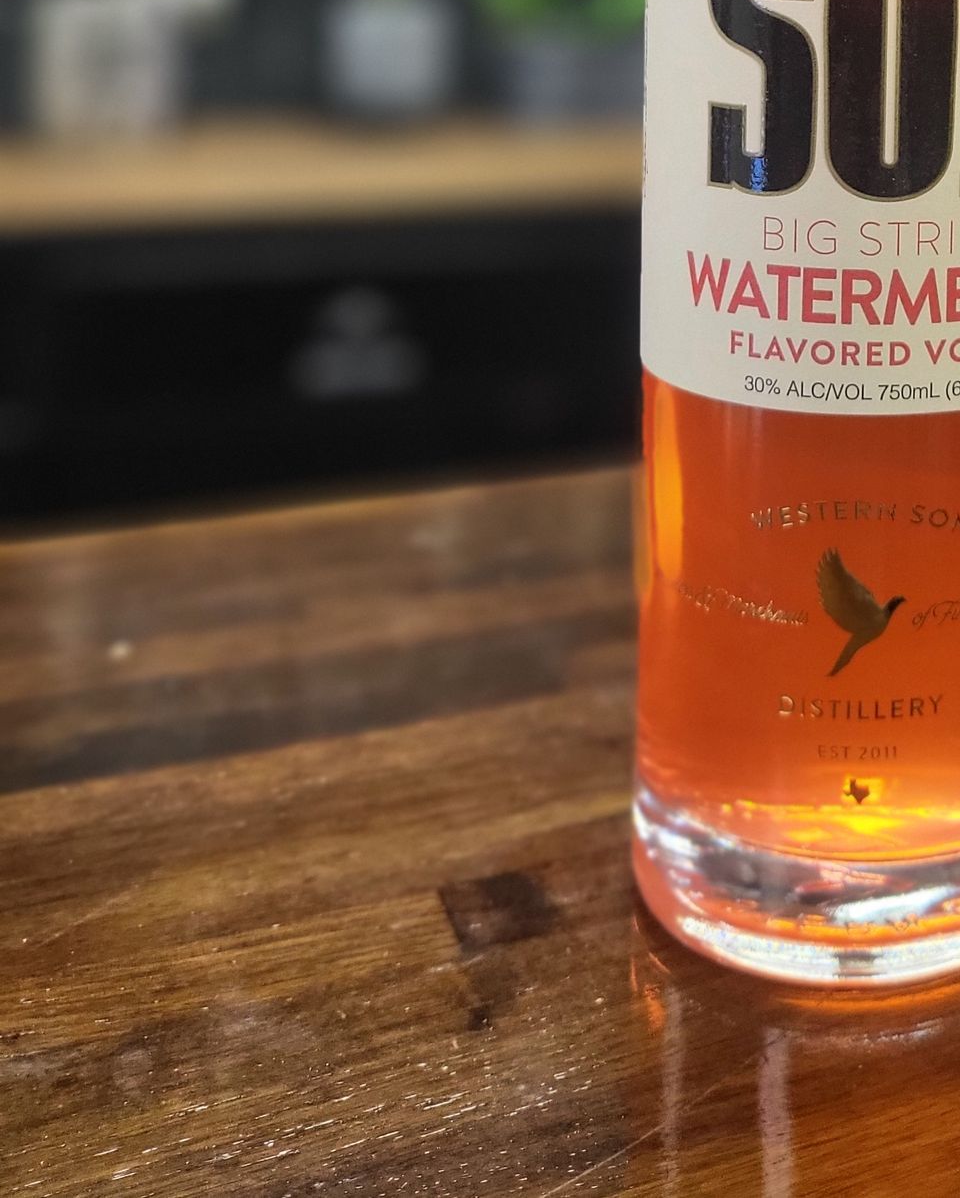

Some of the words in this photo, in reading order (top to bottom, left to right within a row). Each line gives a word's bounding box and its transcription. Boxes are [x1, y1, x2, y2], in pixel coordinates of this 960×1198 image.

[762, 216, 838, 255] BIG
[729, 329, 912, 367] FLAVORED
[744, 375, 781, 395] 30%
[786, 380, 873, 401] ALC/VOL
[877, 382, 941, 401] 750mL
[751, 501, 897, 529] WESTERN
[778, 694, 944, 721] DISTILLERY
[817, 744, 850, 760] EST
[857, 745, 898, 761] 2011
